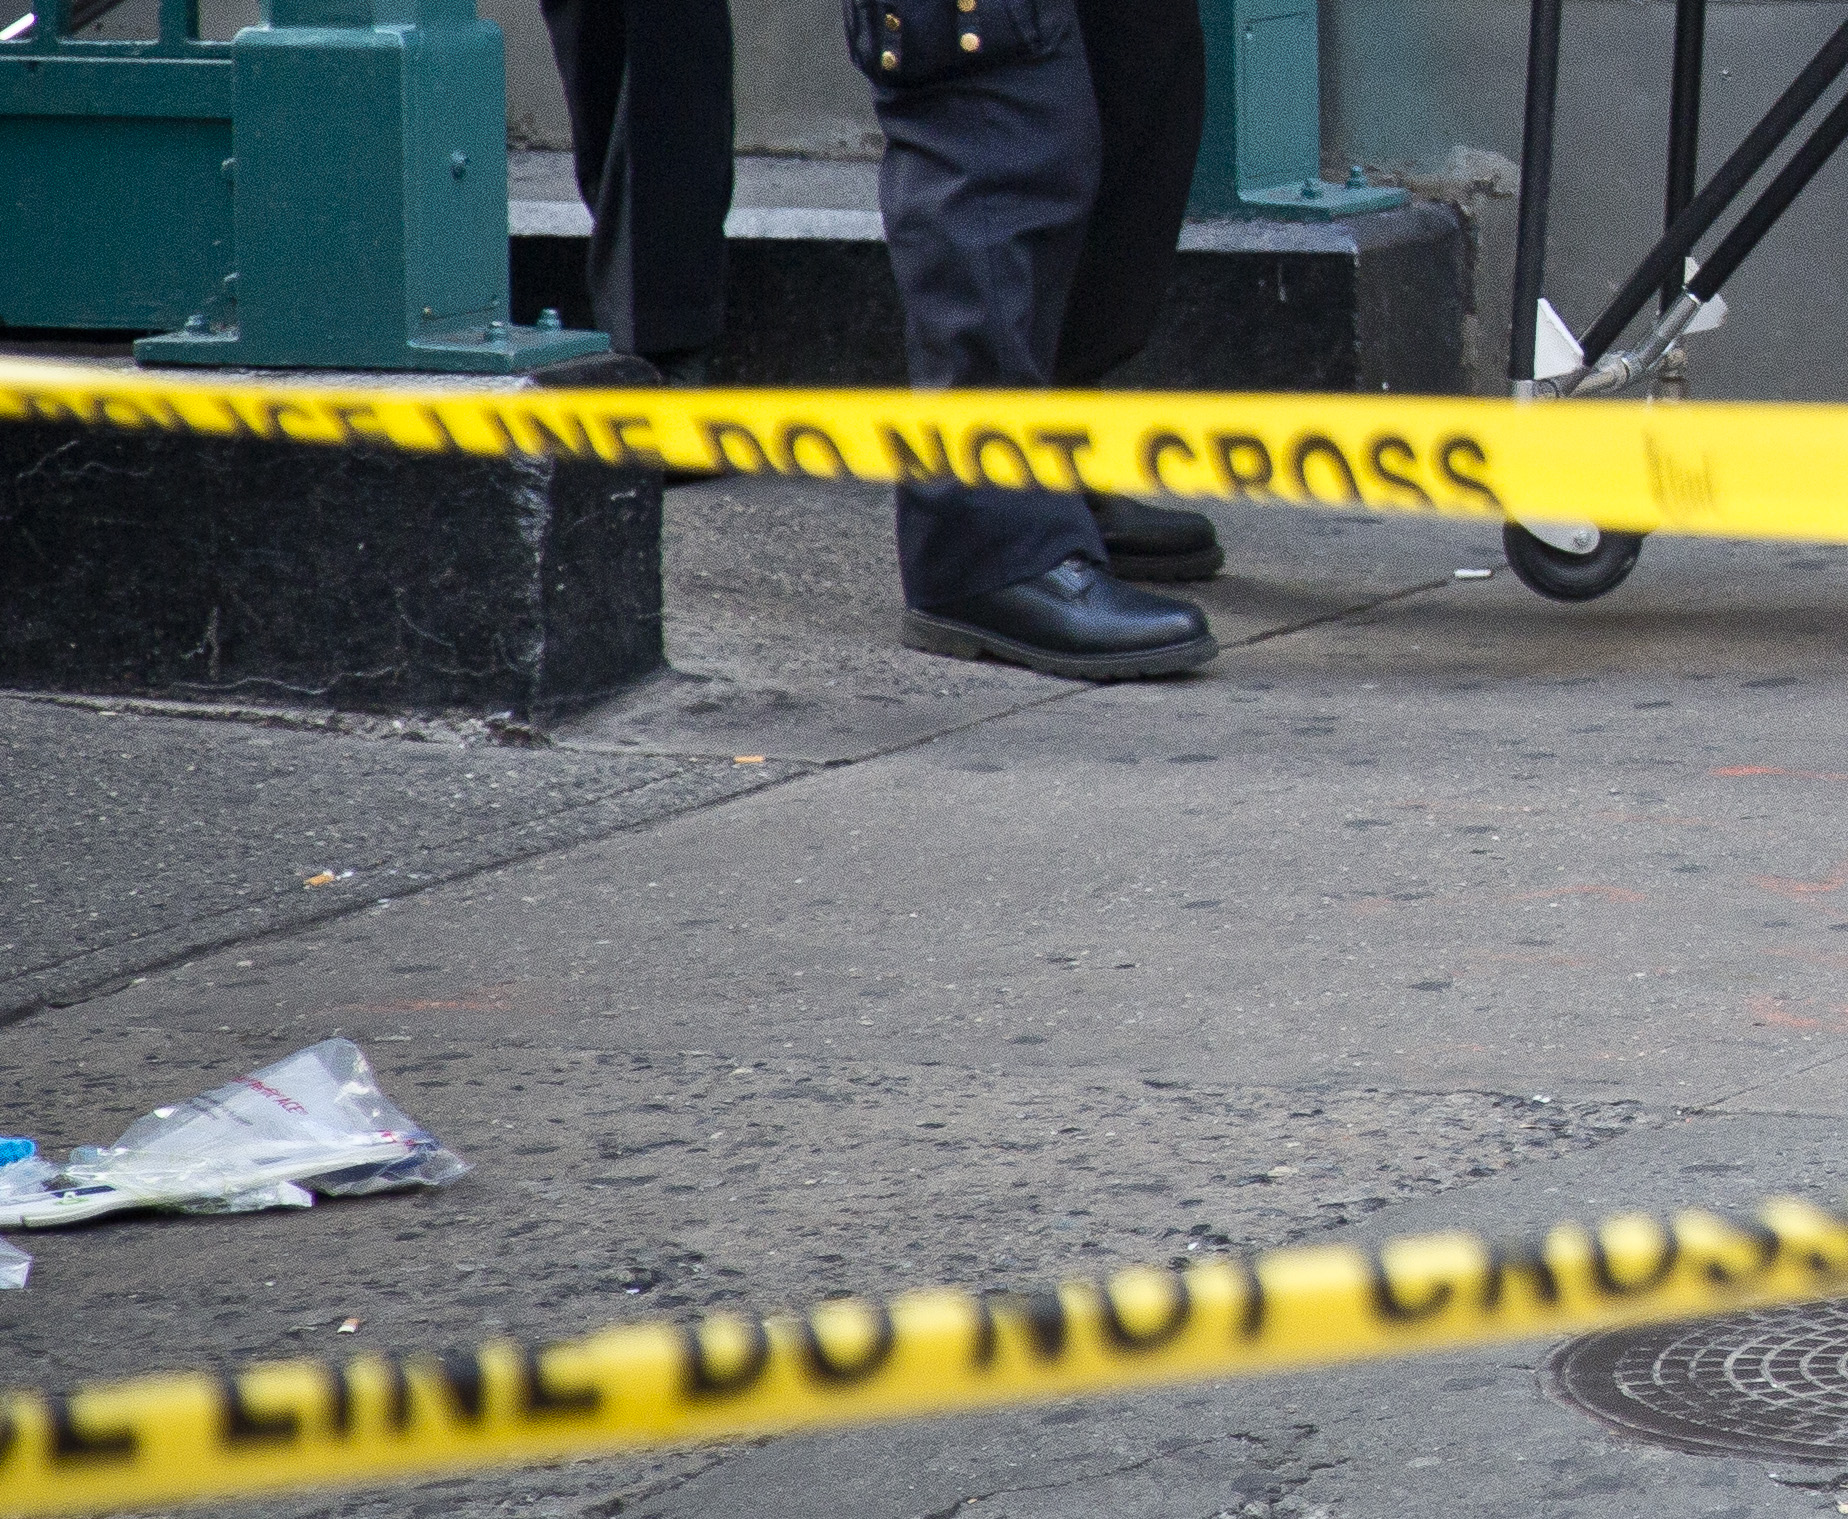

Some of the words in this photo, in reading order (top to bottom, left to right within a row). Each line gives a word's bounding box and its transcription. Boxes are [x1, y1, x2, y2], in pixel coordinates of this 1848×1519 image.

[697, 418, 858, 480] DO
[876, 418, 1093, 488] NOT
[1137, 423, 1510, 514] CROSS
